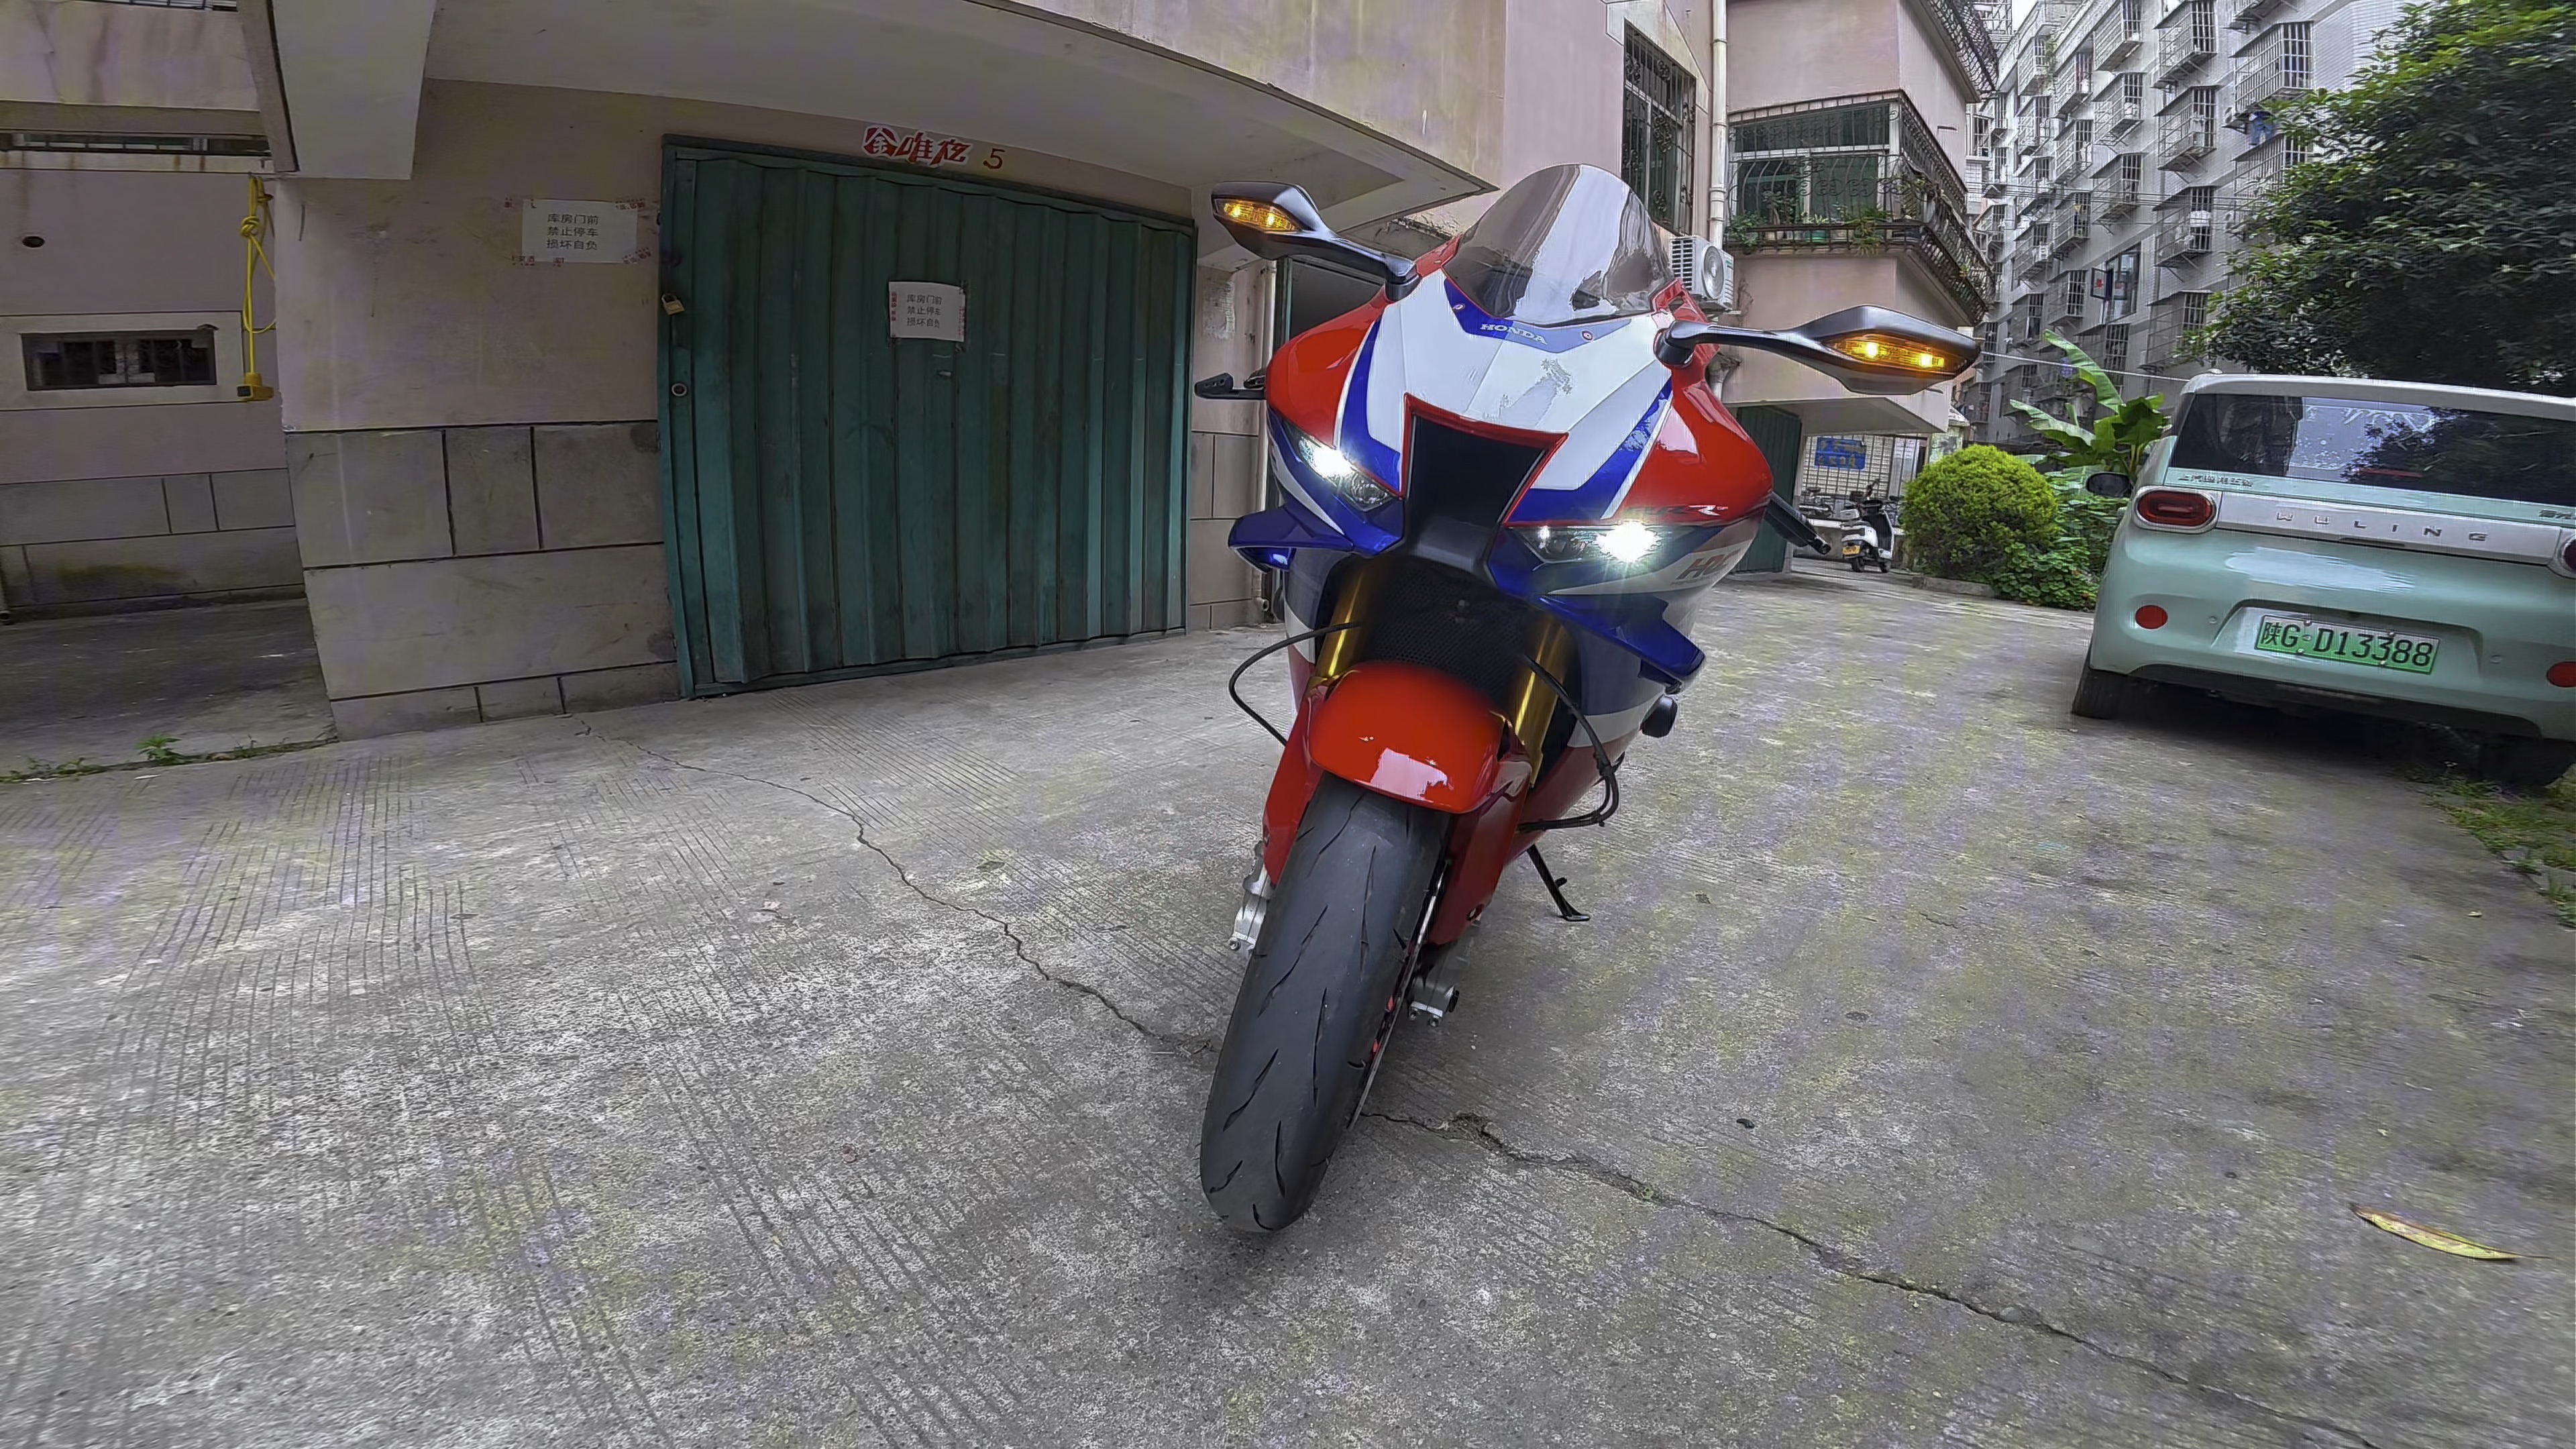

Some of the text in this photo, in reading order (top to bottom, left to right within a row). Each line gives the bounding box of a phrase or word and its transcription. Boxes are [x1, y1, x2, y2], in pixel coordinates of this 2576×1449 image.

[983, 148, 1006, 170] 5
[547, 213, 599, 225] 库房门前
[547, 227, 599, 237] 禁止停车
[546, 239, 598, 250] 损坏自负
[906, 294, 942, 305] 库房门前
[1480, 323, 1548, 345] HONDA
[2276, 511, 2487, 542] WULING
